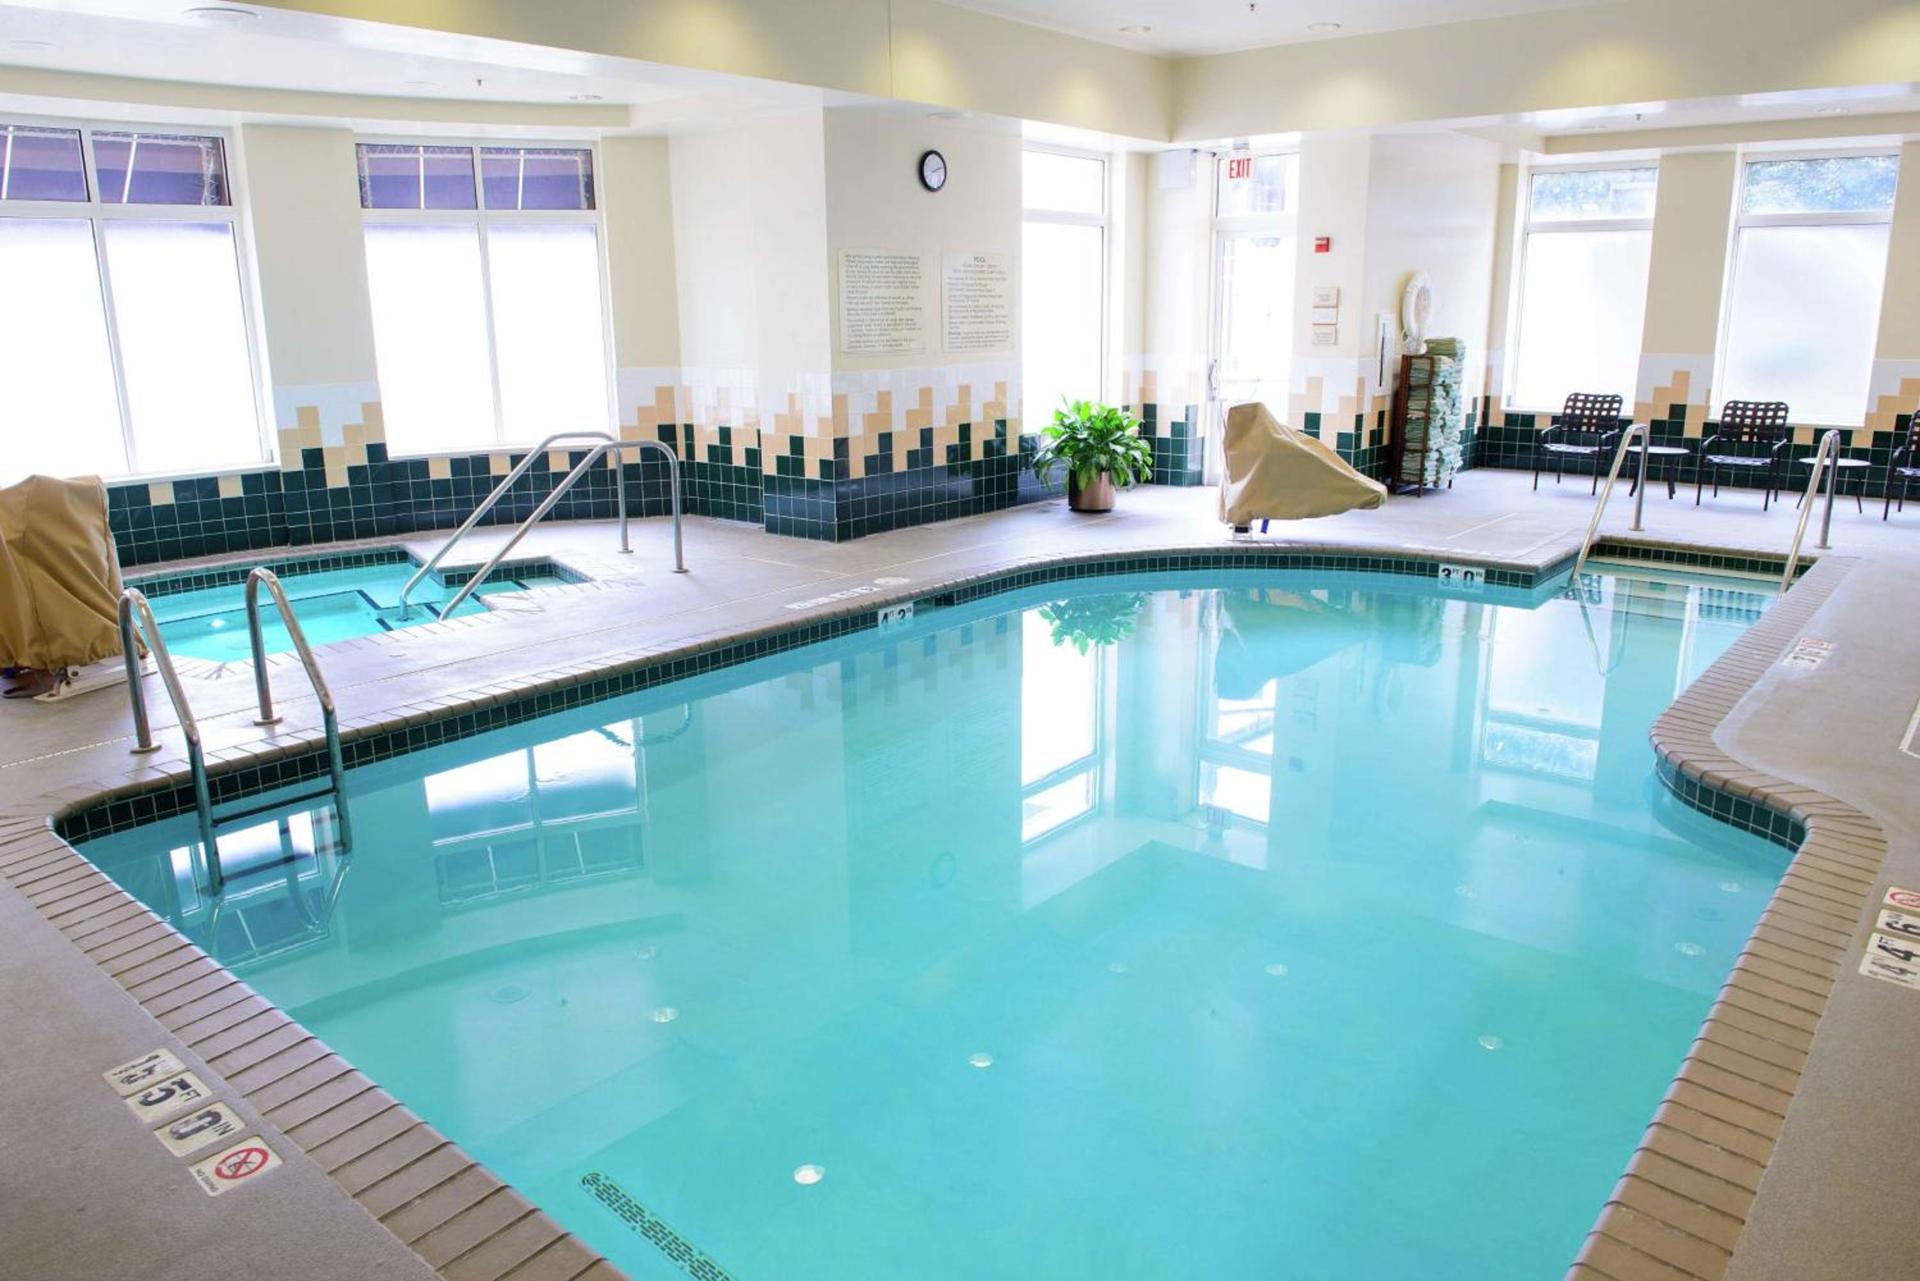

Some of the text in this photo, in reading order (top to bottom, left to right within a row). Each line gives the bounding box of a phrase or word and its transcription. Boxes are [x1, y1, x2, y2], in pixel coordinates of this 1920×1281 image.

[1229, 158, 1252, 179] EXIT
[138, 1076, 192, 1107] 5
[179, 1089, 203, 1103] FT
[211, 1121, 237, 1138] IN
